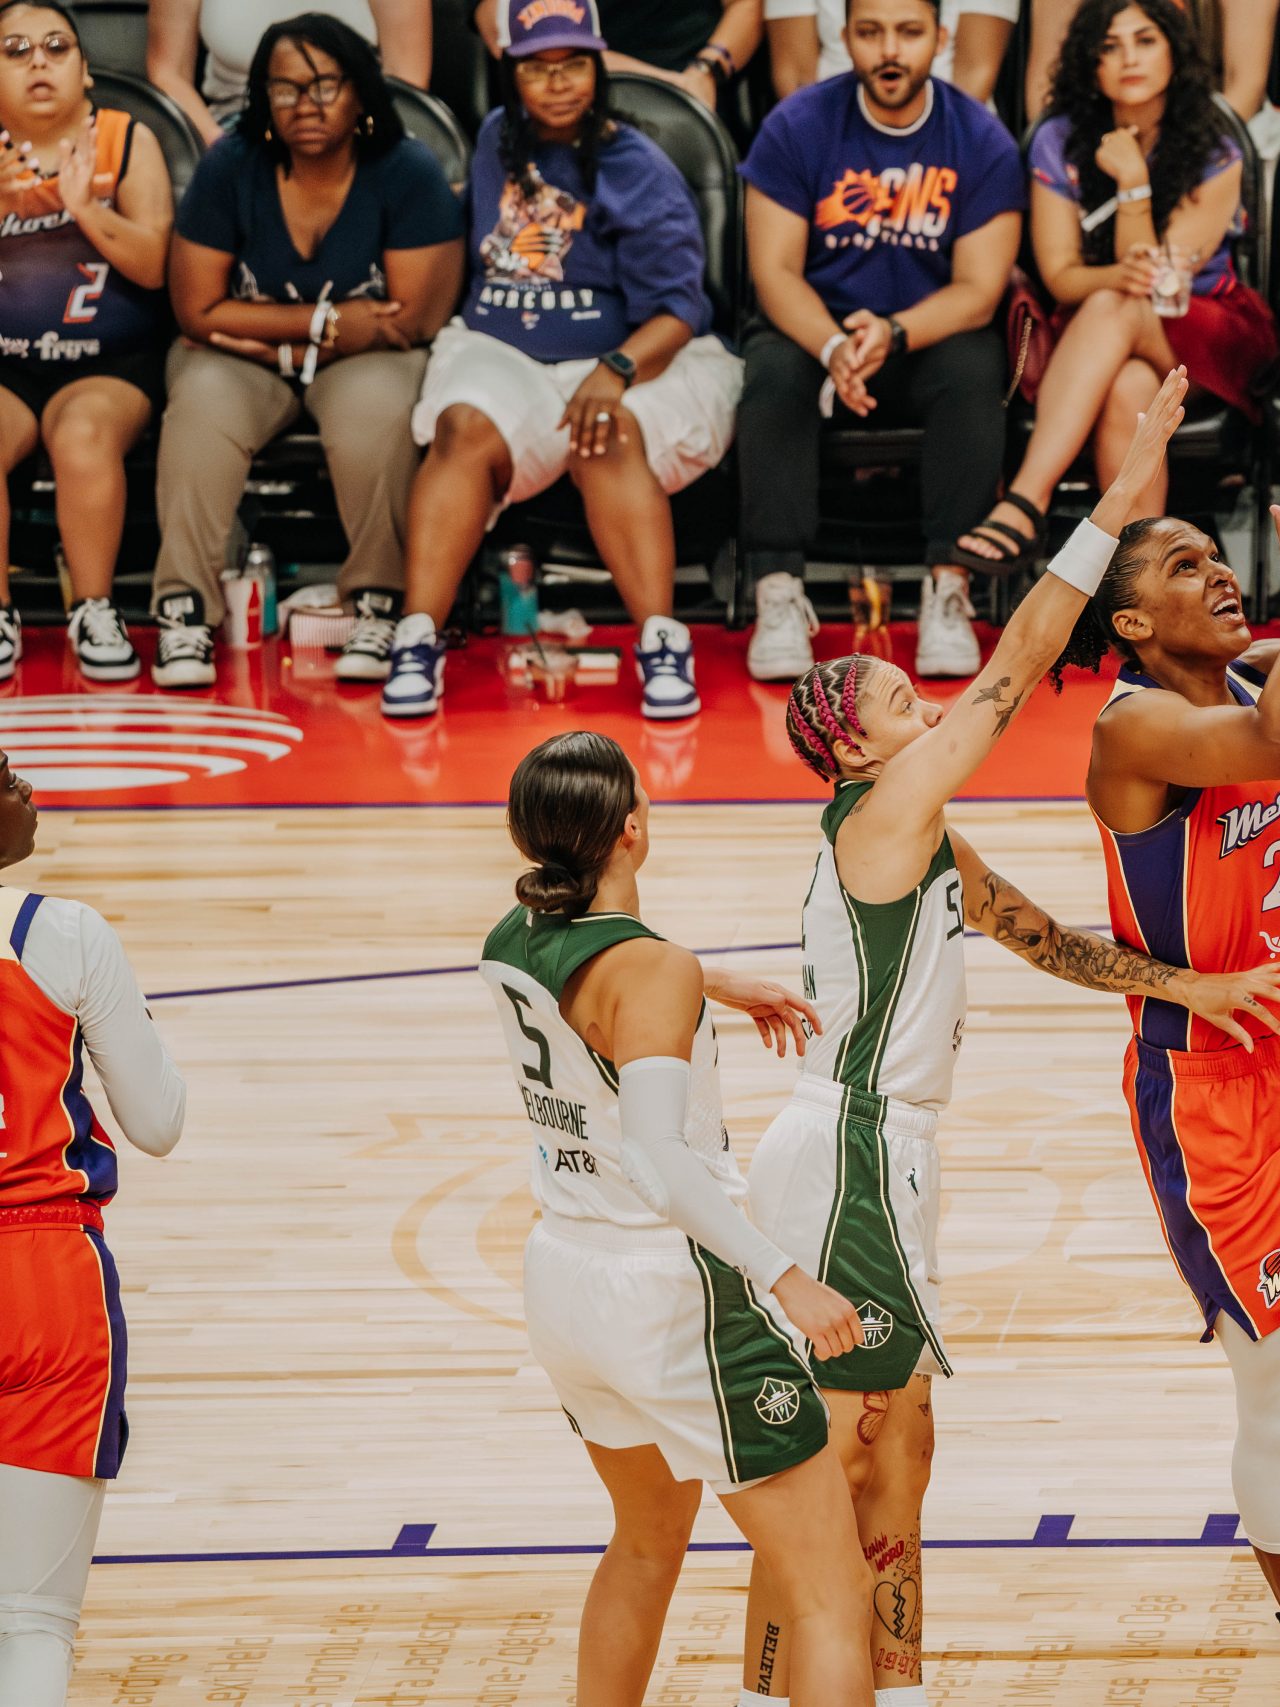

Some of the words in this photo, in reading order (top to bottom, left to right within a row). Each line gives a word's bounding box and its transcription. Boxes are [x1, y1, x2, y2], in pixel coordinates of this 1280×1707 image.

[63, 262, 109, 324] 2
[501, 982, 553, 1090] 5
[1117, 1595, 1186, 1623] Oga
[1194, 1618, 1260, 1657] Shey
[286, 1604, 381, 1697] Hornbuckle
[652, 1646, 718, 1707] ennifer
[757, 1621, 780, 1696] BELIEVE
[1000, 1635, 1075, 1698] Mitchell
[1101, 1631, 1165, 1667] Yuko
